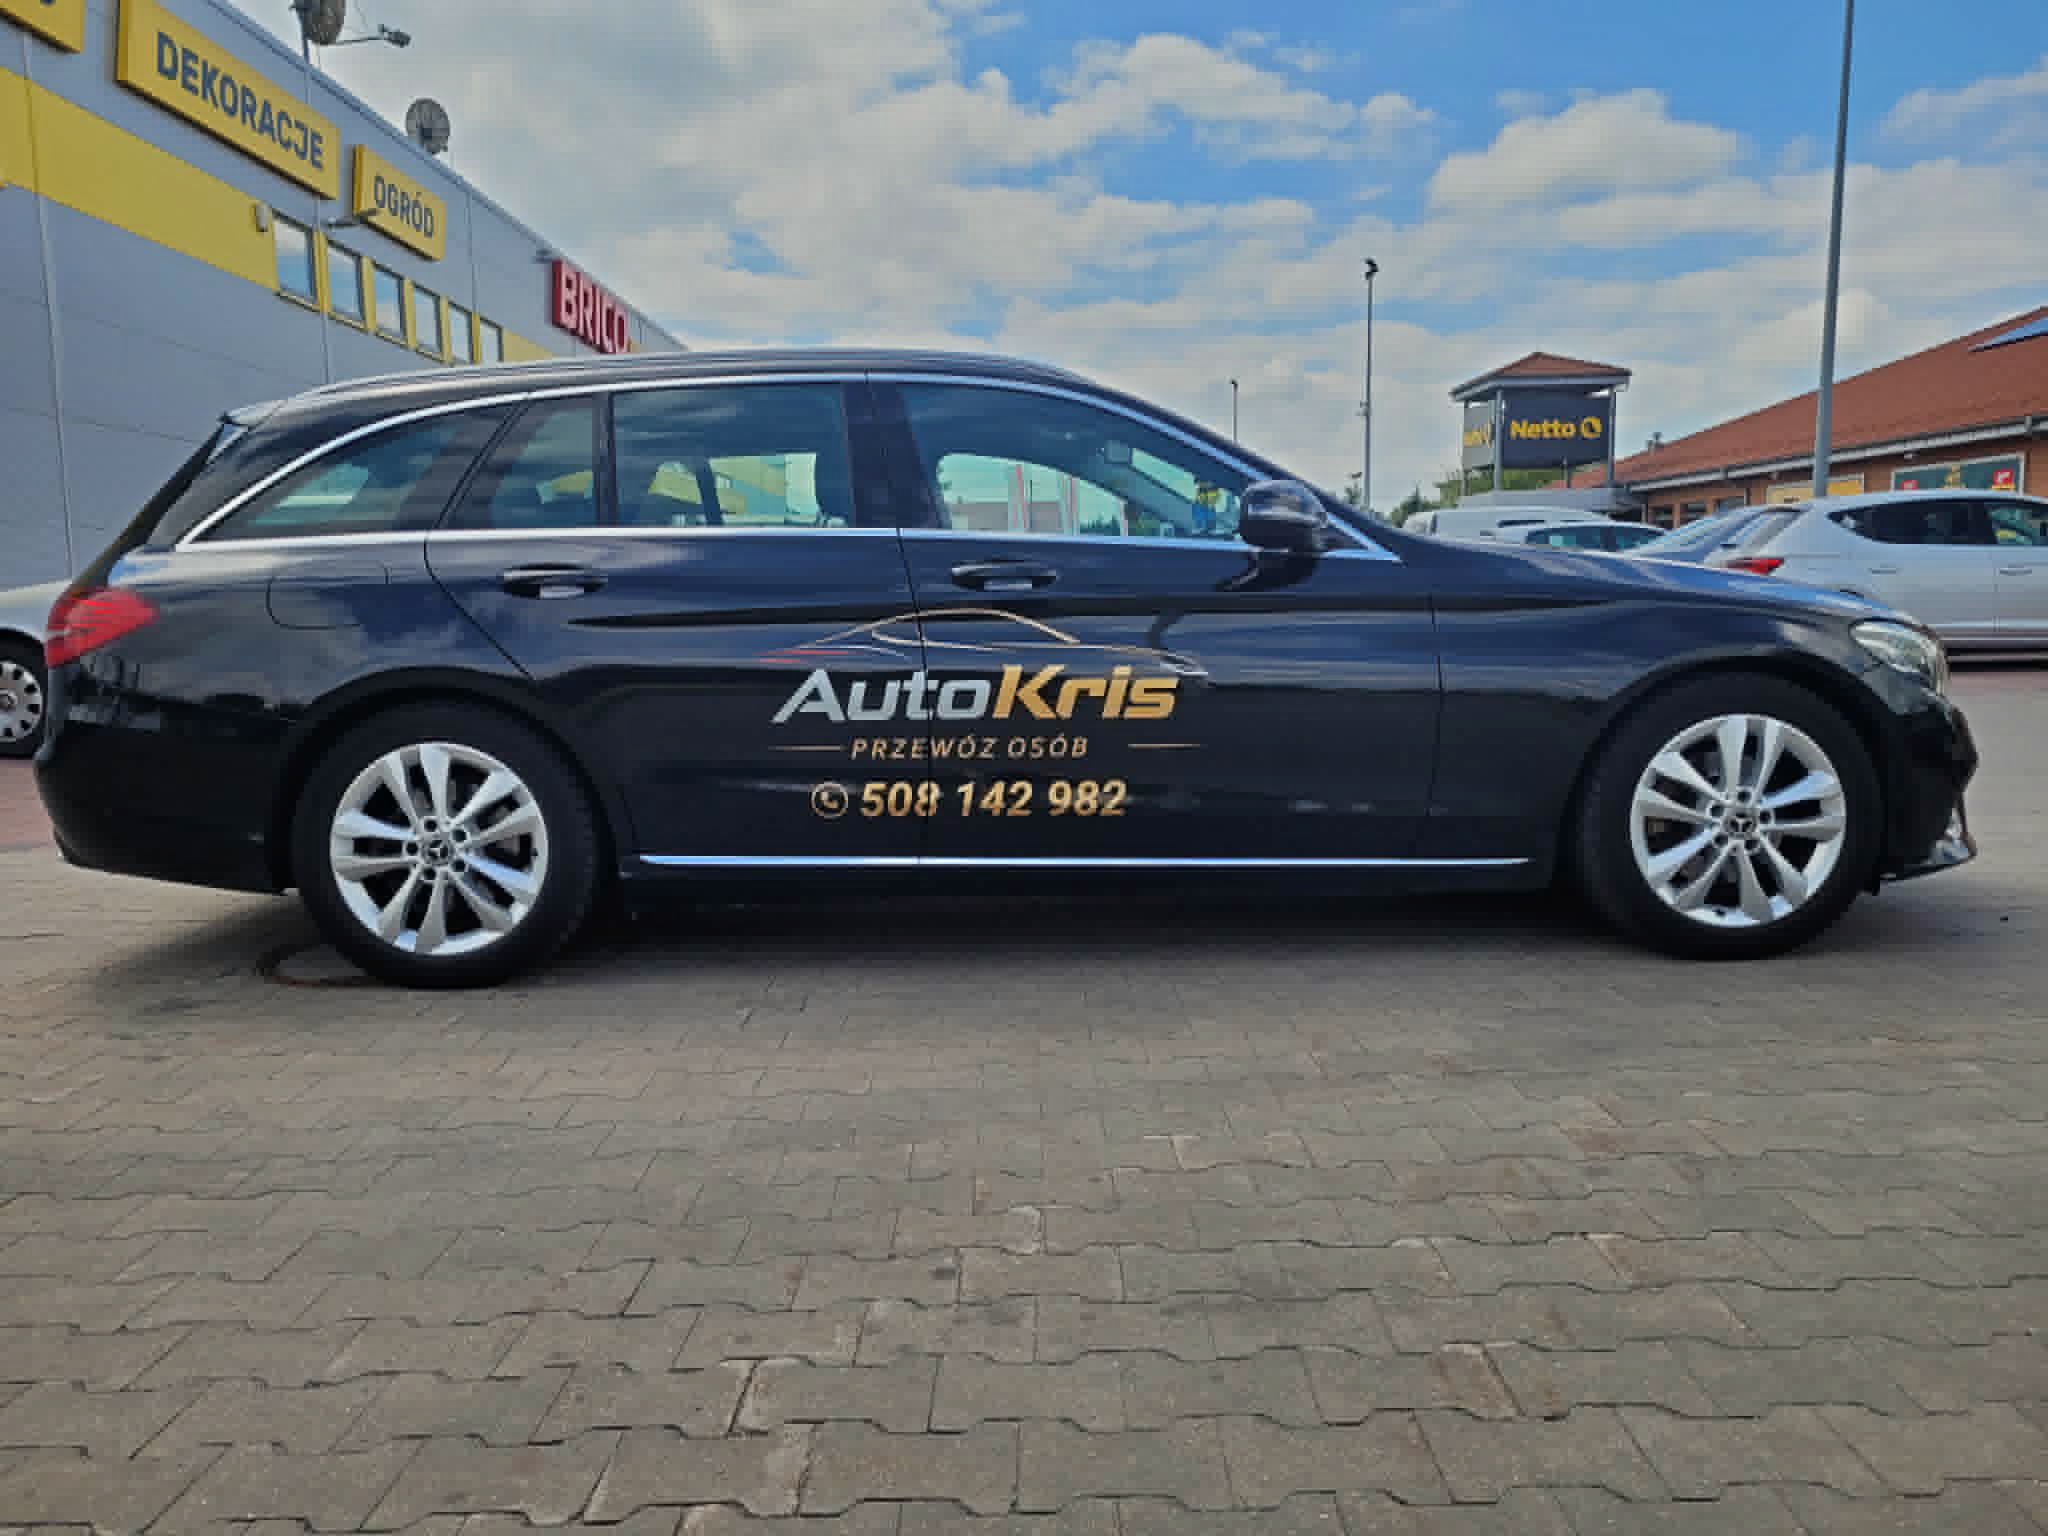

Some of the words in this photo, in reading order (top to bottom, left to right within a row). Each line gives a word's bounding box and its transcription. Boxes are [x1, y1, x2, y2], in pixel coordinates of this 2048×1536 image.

[157, 31, 323, 171] DEKORACJE
[374, 175, 434, 238] OGRÓD
[1509, 418, 1576, 440] Netto
[770, 664, 1179, 723] AutoKris
[850, 734, 998, 760] PRZEWÓZ
[1007, 733, 1088, 759] OSÓB
[861, 781, 940, 817] 508
[957, 780, 1033, 817] 142
[1048, 780, 1127, 817] 982
